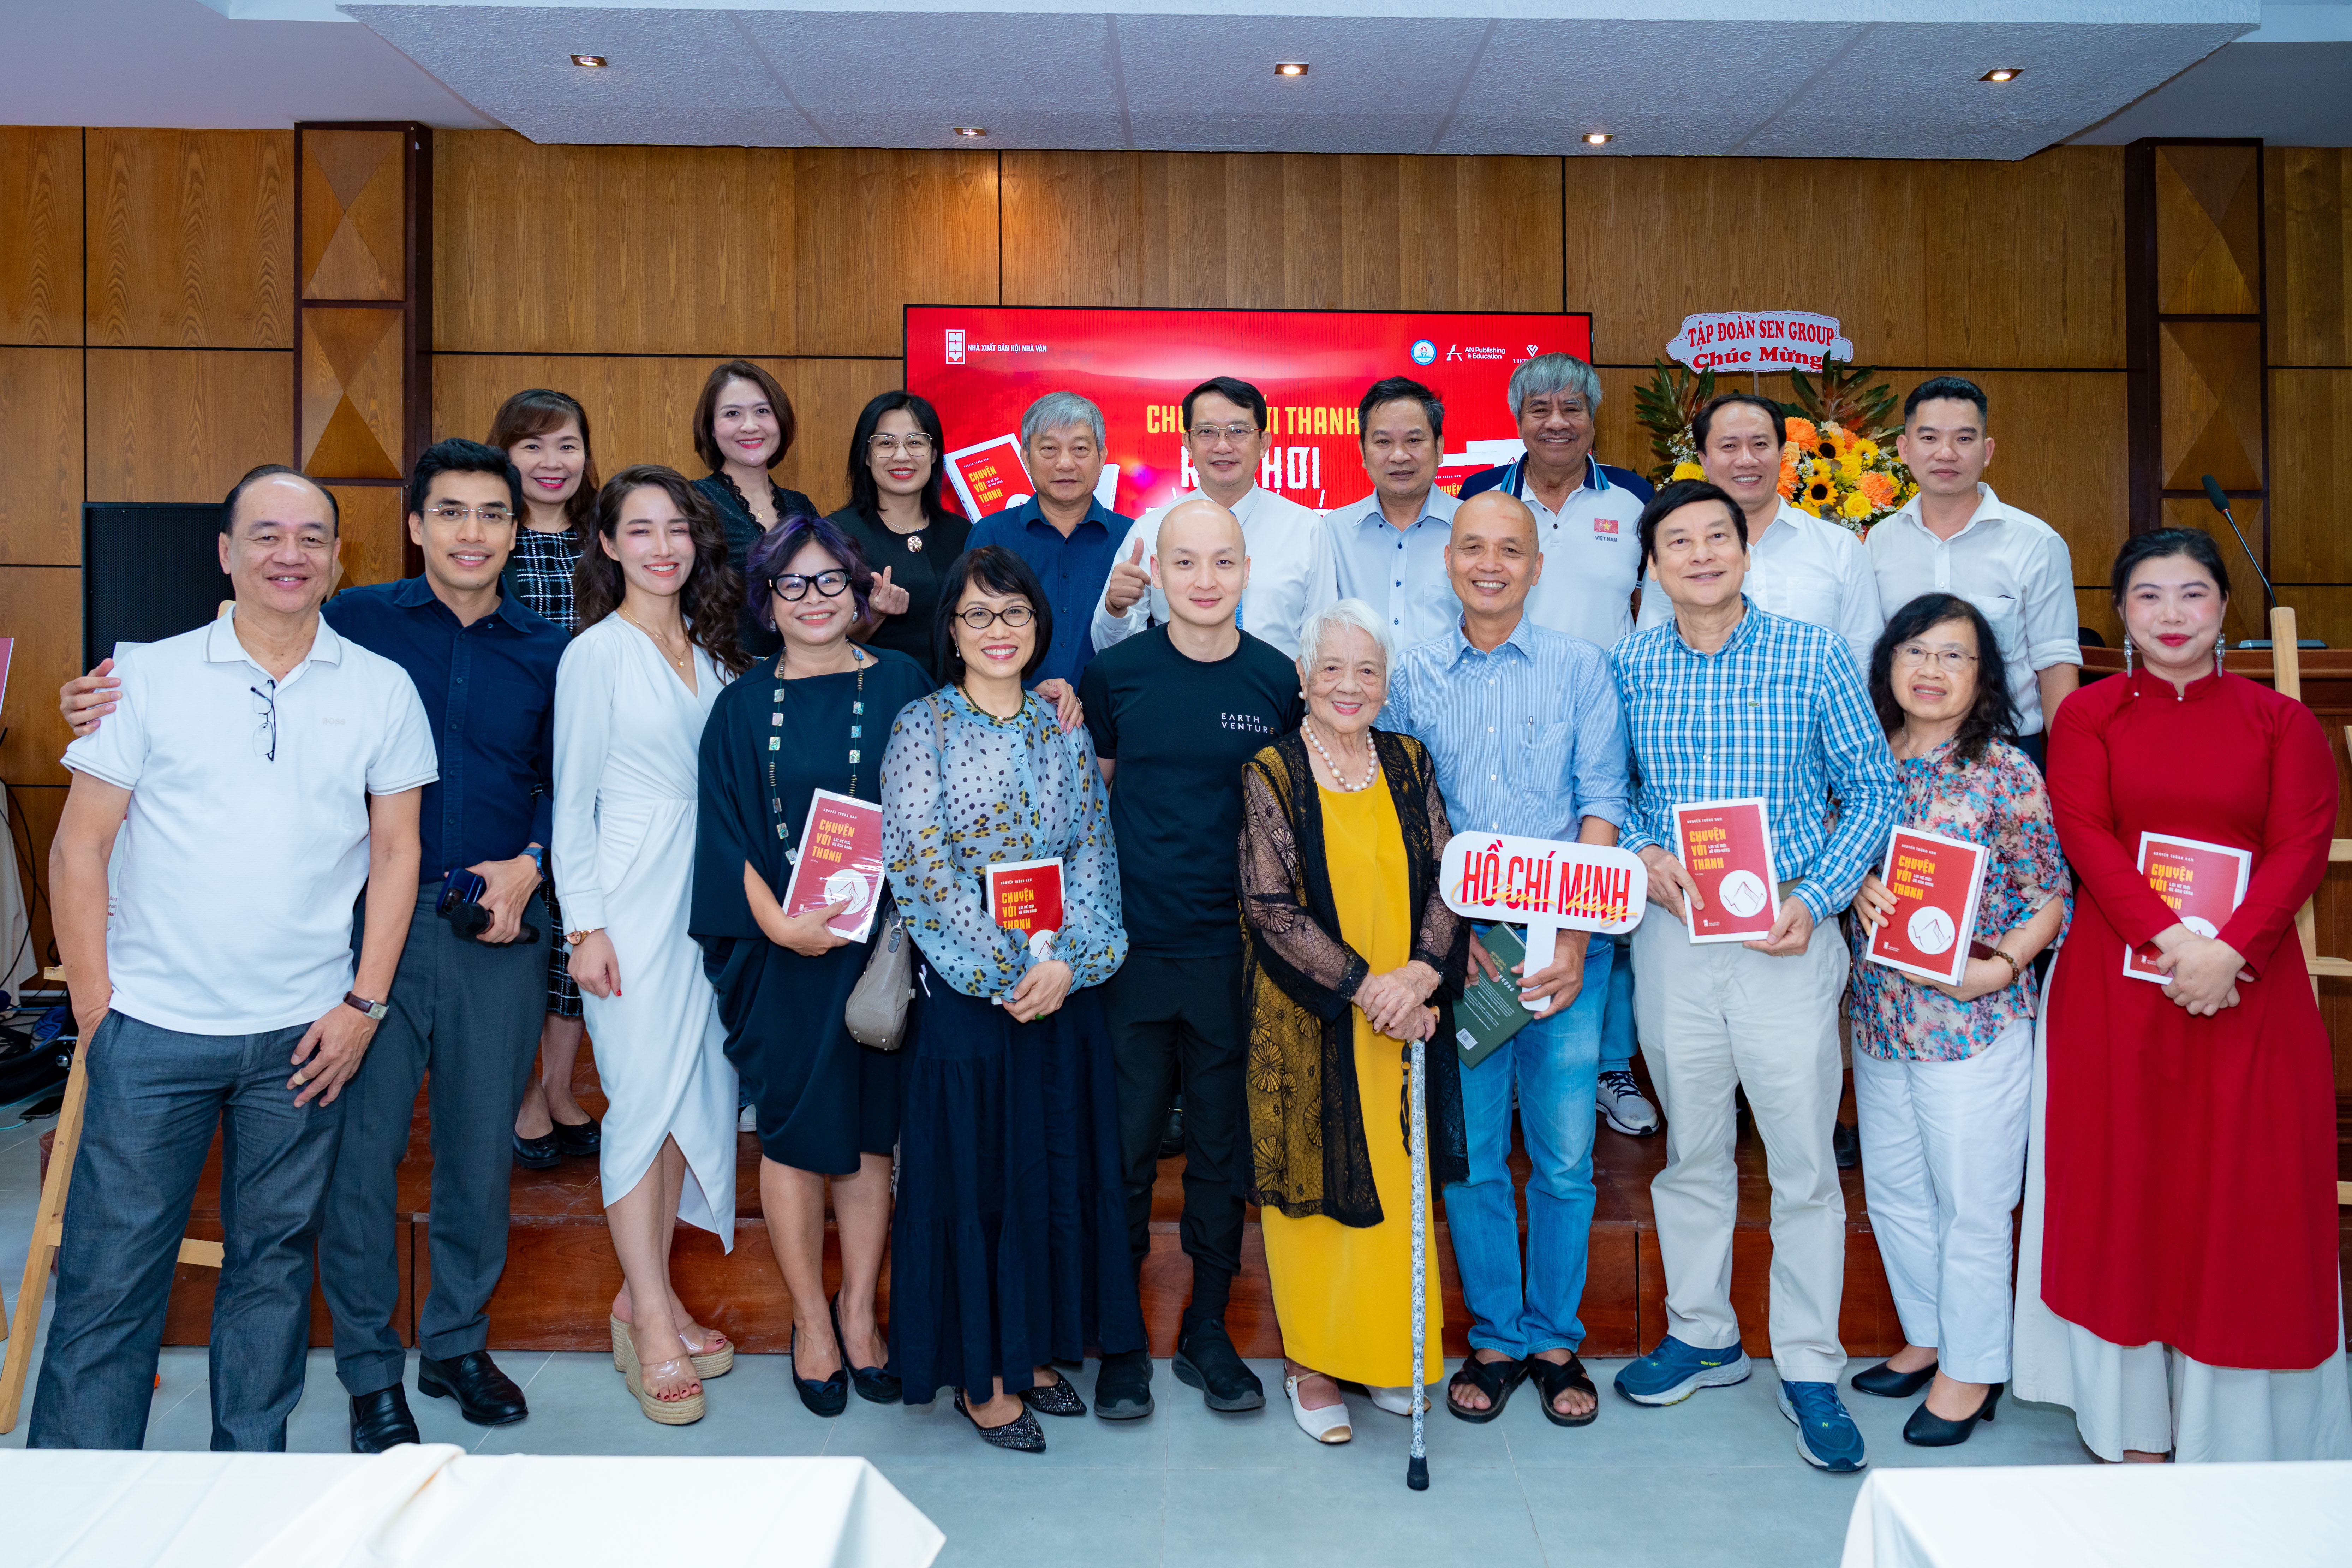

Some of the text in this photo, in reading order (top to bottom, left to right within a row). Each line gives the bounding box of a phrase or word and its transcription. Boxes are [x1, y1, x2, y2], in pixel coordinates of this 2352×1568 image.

[1688, 315, 1834, 351] TẬP ĐOÀN SEN GROUP
[967, 343, 980, 351] NHÀ
[981, 342, 996, 351] XUẤT
[997, 343, 1009, 352] BẢN
[1011, 344, 1020, 353] HỘI
[1035, 344, 1047, 352] VĂN
[1693, 347, 1822, 370] Chúc Mừng
[1285, 407, 1360, 435] THANH
[968, 466, 997, 482] CHUYỆN
[973, 479, 987, 493] VỚI
[978, 488, 1003, 503] THANH
[1222, 713, 1259, 723] EARTH
[1221, 722, 1274, 734] VENTURE
[819, 819, 855, 837] CHUYỆN
[1689, 827, 1726, 842] CHUYỆN
[816, 831, 831, 846] VỚI
[812, 846, 842, 863] THANH
[1691, 842, 1707, 856] VỚI
[1692, 857, 1724, 870] THANH
[1898, 855, 1935, 874] CHUYỆN
[1896, 868, 1912, 883] VỚI
[2151, 863, 2193, 882] CHUYỆN
[1462, 839, 1631, 922] HỒ CHÍ MINH
[1002, 888, 1034, 904] CHUYỆN
[1893, 882, 1924, 900] THANH
[1002, 903, 1016, 917] VỚI
[1003, 918, 1031, 929] THANH
